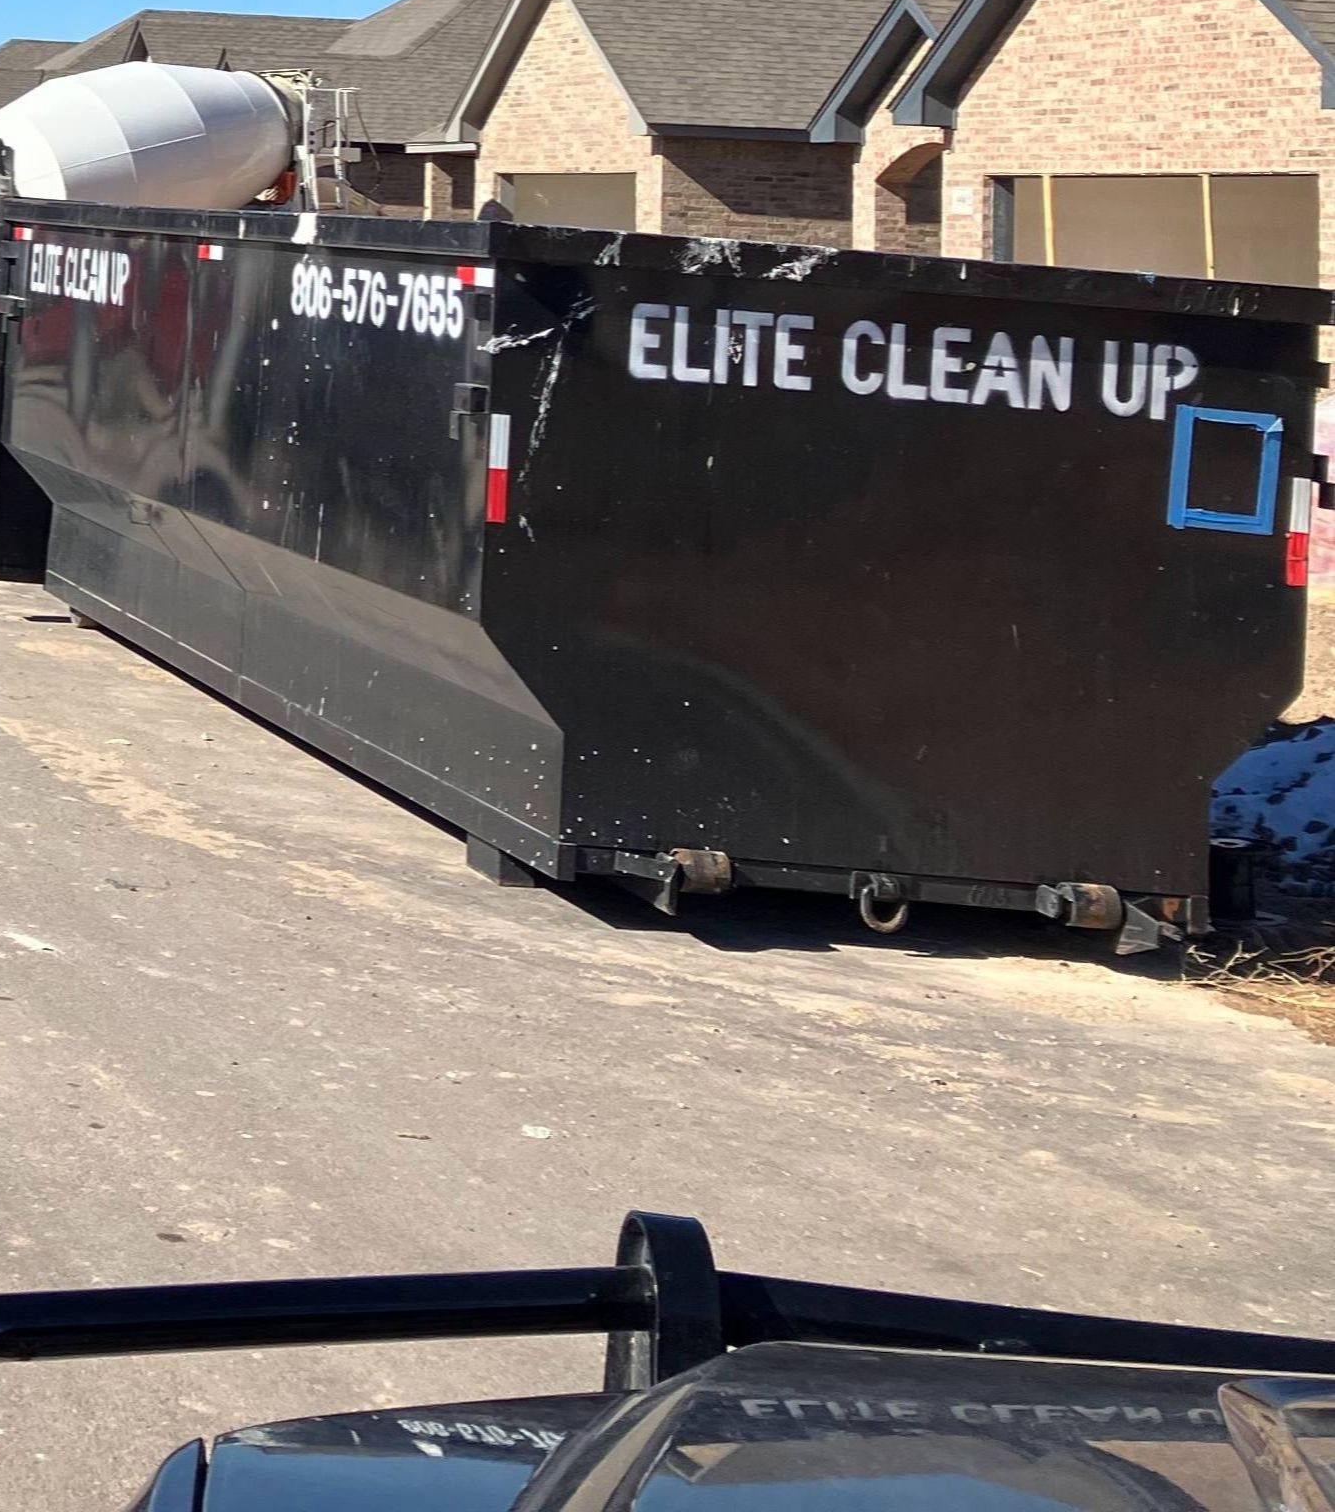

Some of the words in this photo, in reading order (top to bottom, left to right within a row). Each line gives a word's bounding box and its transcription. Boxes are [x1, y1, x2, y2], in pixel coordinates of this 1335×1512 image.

[30, 242, 64, 296] ELITE
[64, 246, 109, 305] CLEAN
[110, 251, 130, 307] UP
[290, 262, 464, 339] 806-576-7655
[629, 302, 816, 391] ELITE
[840, 318, 1075, 413] CLEAN
[1101, 341, 1200, 420] UP
